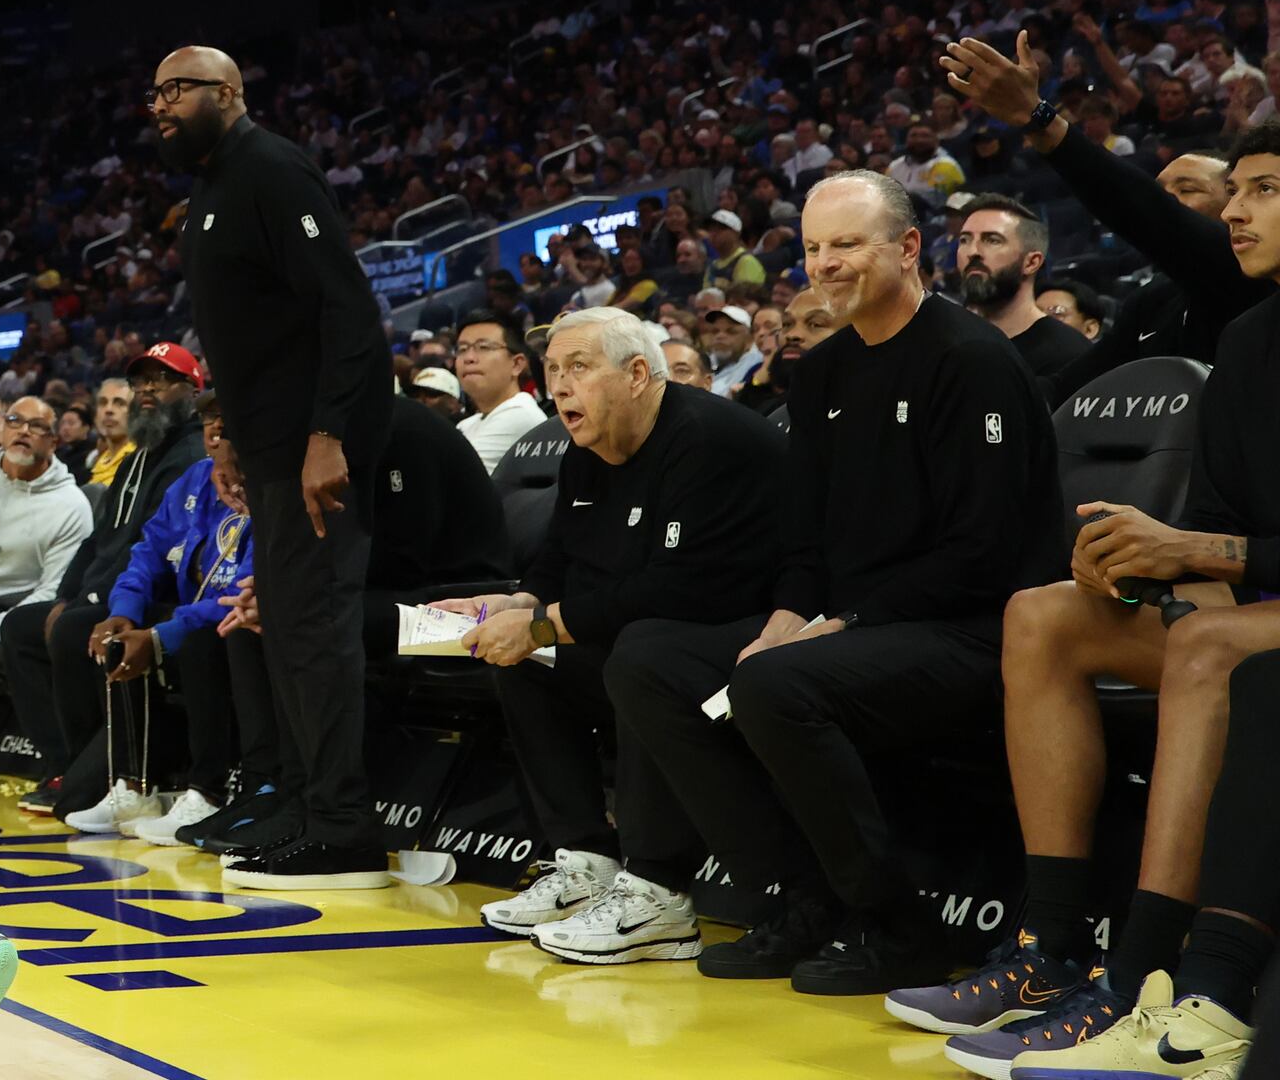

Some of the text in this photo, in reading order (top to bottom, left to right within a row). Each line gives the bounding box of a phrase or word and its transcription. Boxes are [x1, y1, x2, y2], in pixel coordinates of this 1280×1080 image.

[1072, 392, 1191, 420] WAYMO
[514, 439, 570, 458] WAYM
[435, 827, 533, 862] WAYMO
